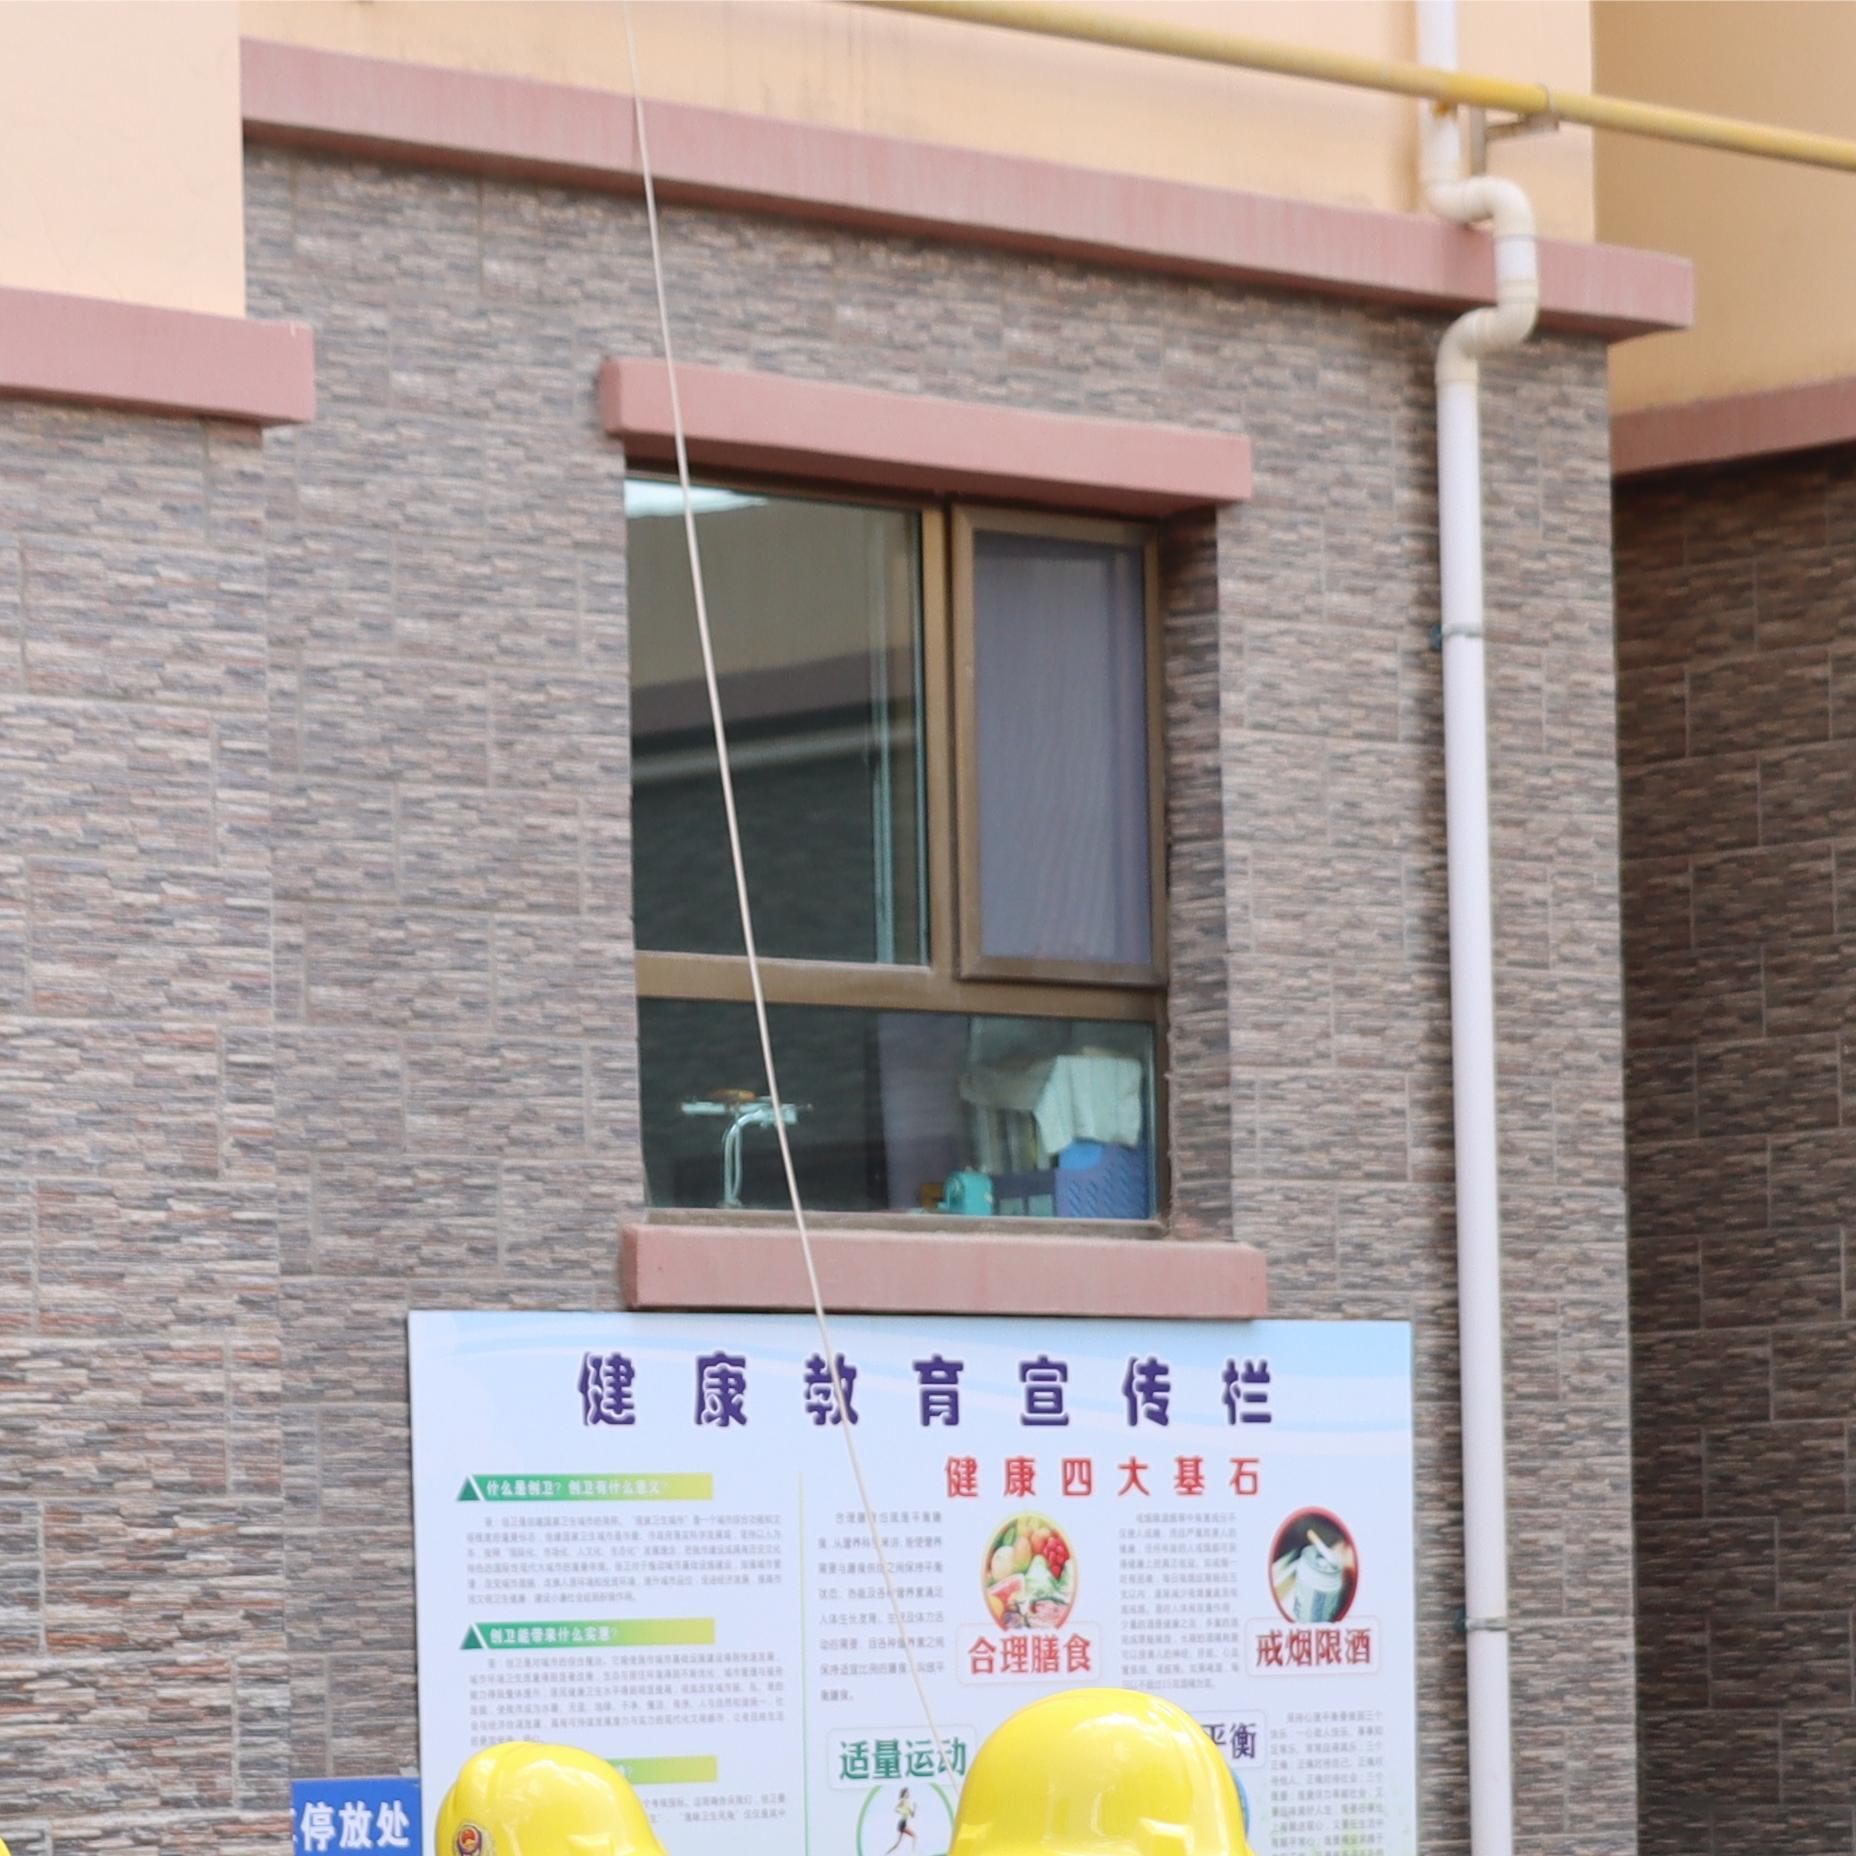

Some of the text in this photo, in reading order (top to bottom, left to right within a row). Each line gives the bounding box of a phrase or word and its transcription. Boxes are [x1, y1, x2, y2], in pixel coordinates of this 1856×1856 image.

[578, 1350, 1272, 1427] 健康教育宣传栏
[944, 1455, 1261, 1498] 健康四大基石
[967, 1634, 1093, 1676] 合理膳食
[1255, 1628, 1372, 1668] 戒烟限酒
[838, 1736, 968, 1781] 适量运动
[290, 1800, 410, 1852] 停放处
